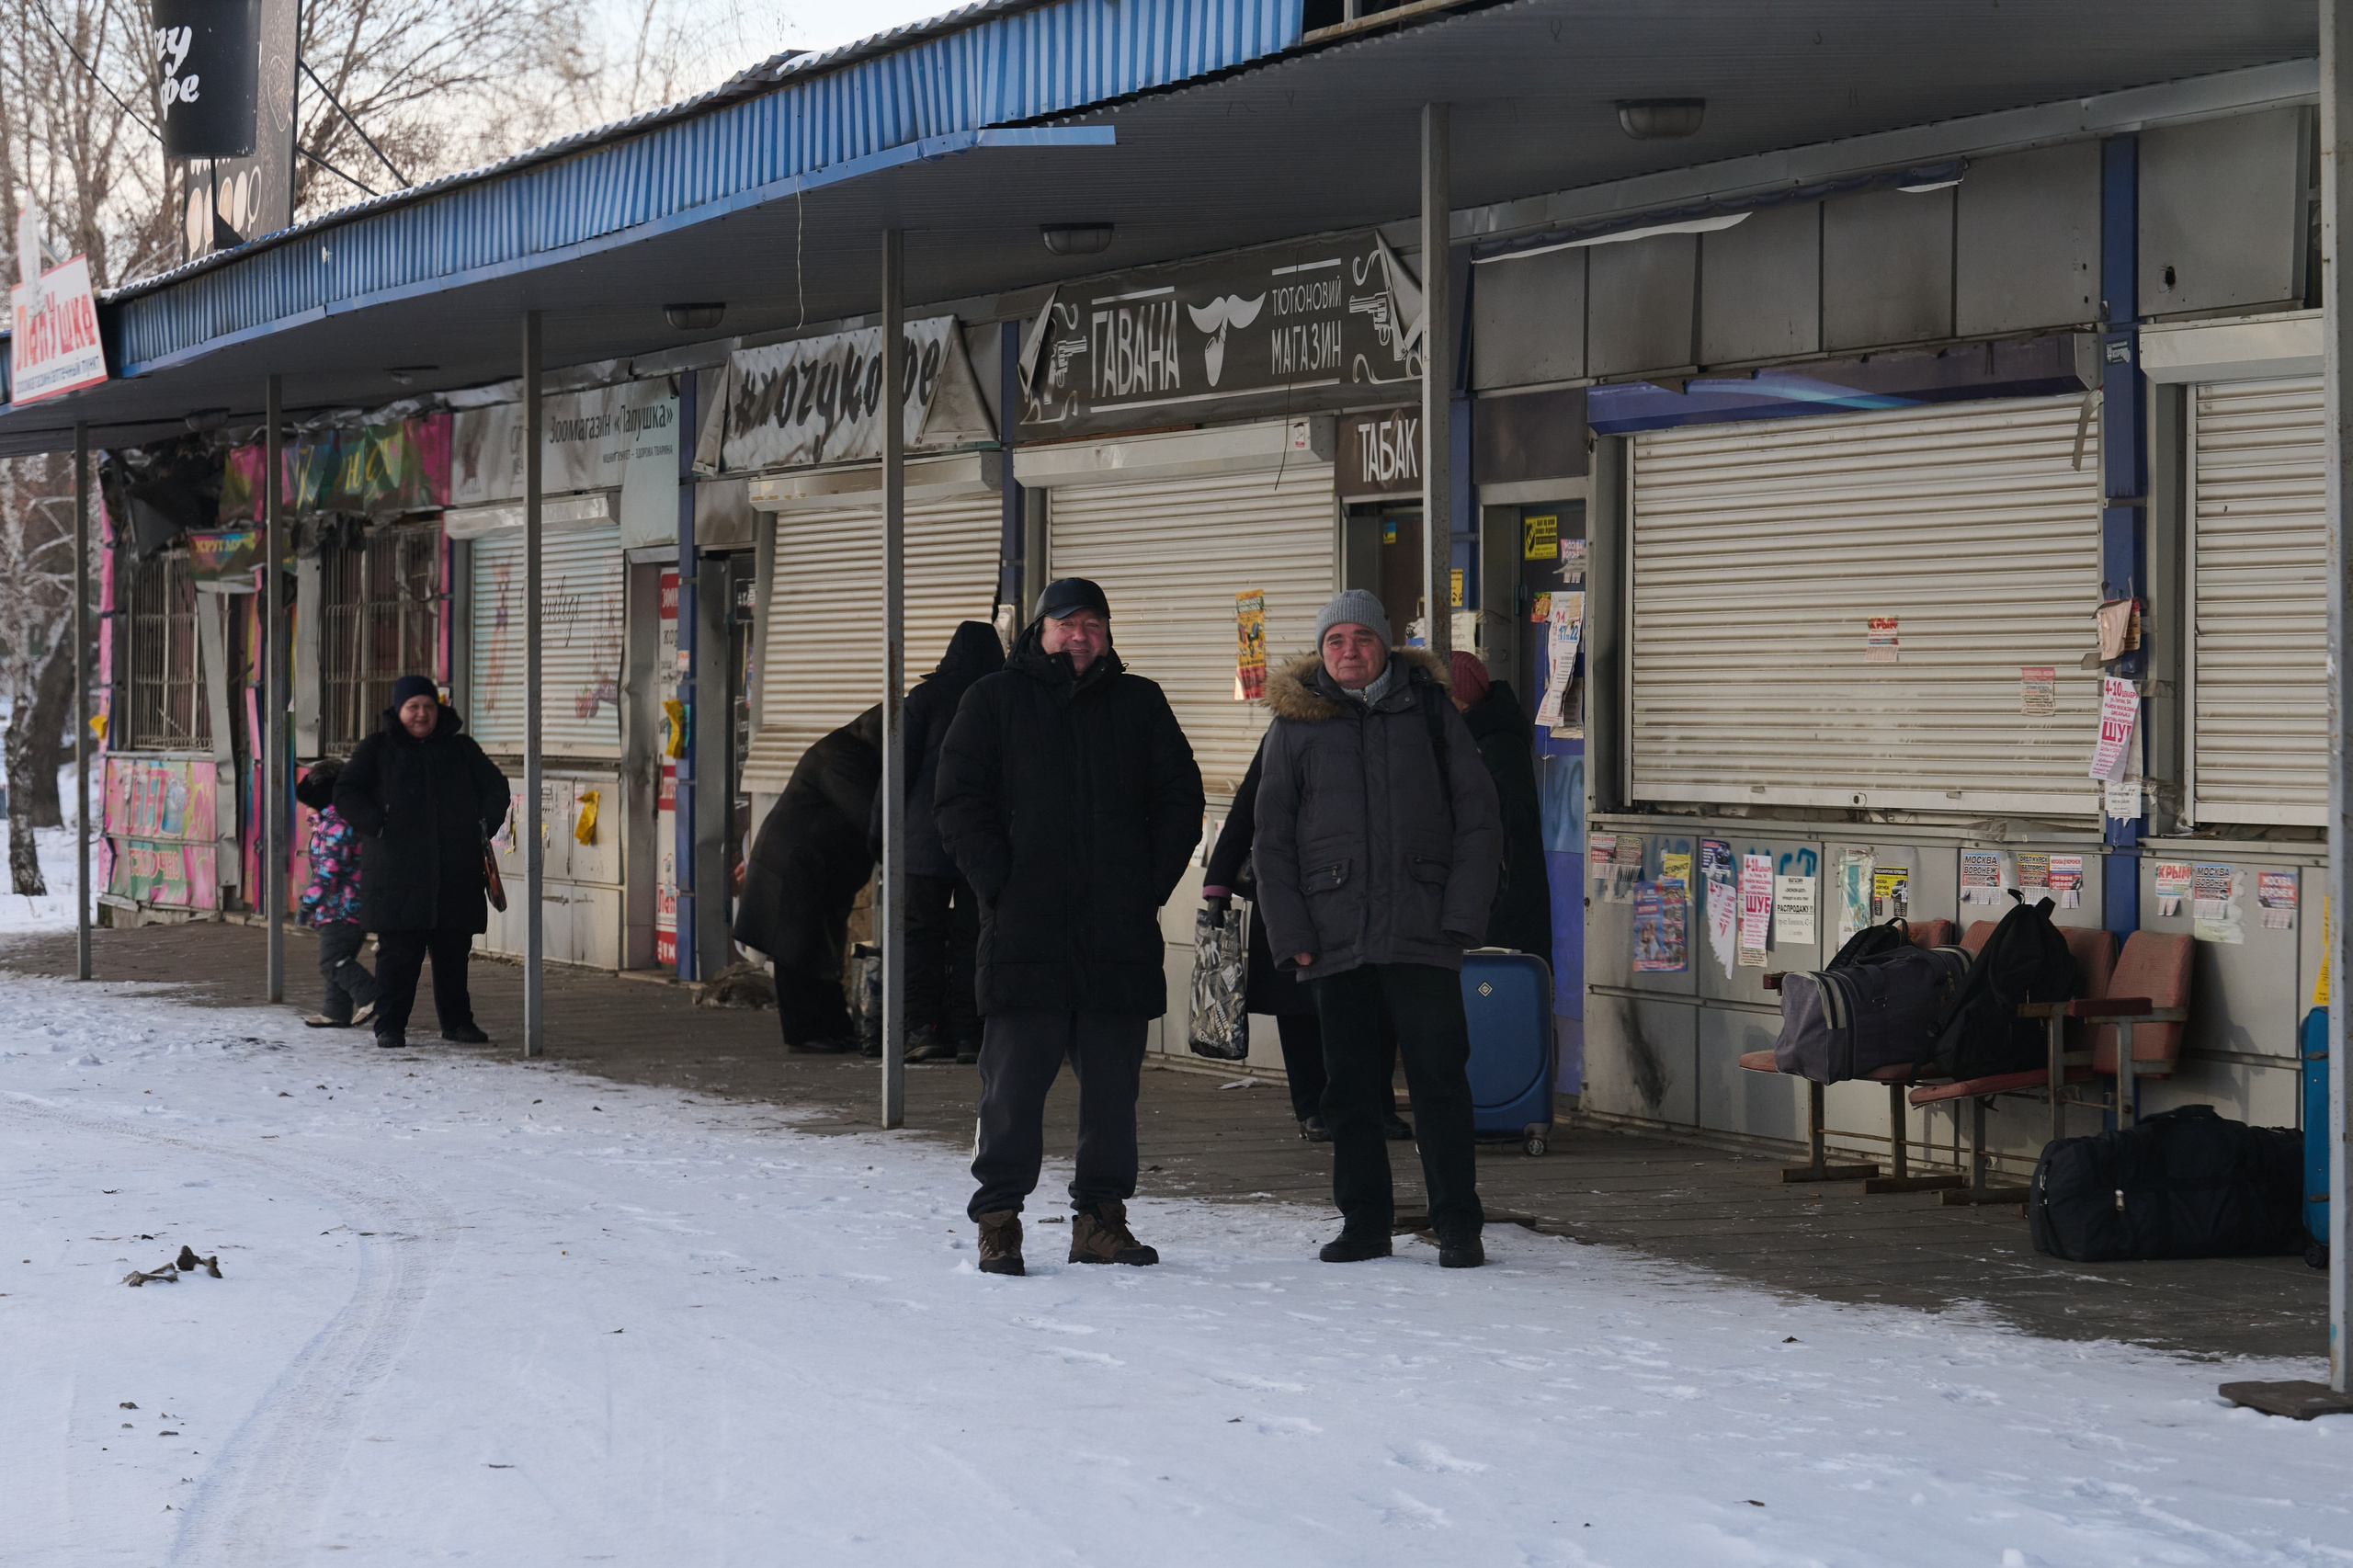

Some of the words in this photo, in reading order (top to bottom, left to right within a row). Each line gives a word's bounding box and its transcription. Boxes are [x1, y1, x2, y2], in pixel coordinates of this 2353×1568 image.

[1272, 275, 1342, 316] ТЮТЮНОВИЙ
[1091, 300, 1181, 399] ГАВАНА
[1272, 320, 1342, 375] МАГАЗИН
[550, 413, 611, 443] Зоомагазин
[1358, 417, 1418, 483] ТАБАК
[1870, 617, 1897, 630] КРЫМ
[2105, 679, 2122, 698] 4-10
[1964, 856, 1997, 866] МОСКВА
[1963, 866, 1997, 875] ВОРОНЕЖ
[2158, 865, 2191, 879] КРЫМ
[2197, 867, 2230, 876] МОСКВА
[2195, 878, 2229, 888] ВОРОНЕЖ
[2263, 876, 2292, 885] МОСКВА
[2259, 887, 2295, 897] ВОРОНЕЖ
[1745, 895, 1771, 914] ШУБ
[1778, 904, 1809, 914] РАСПРОДАЖУ
